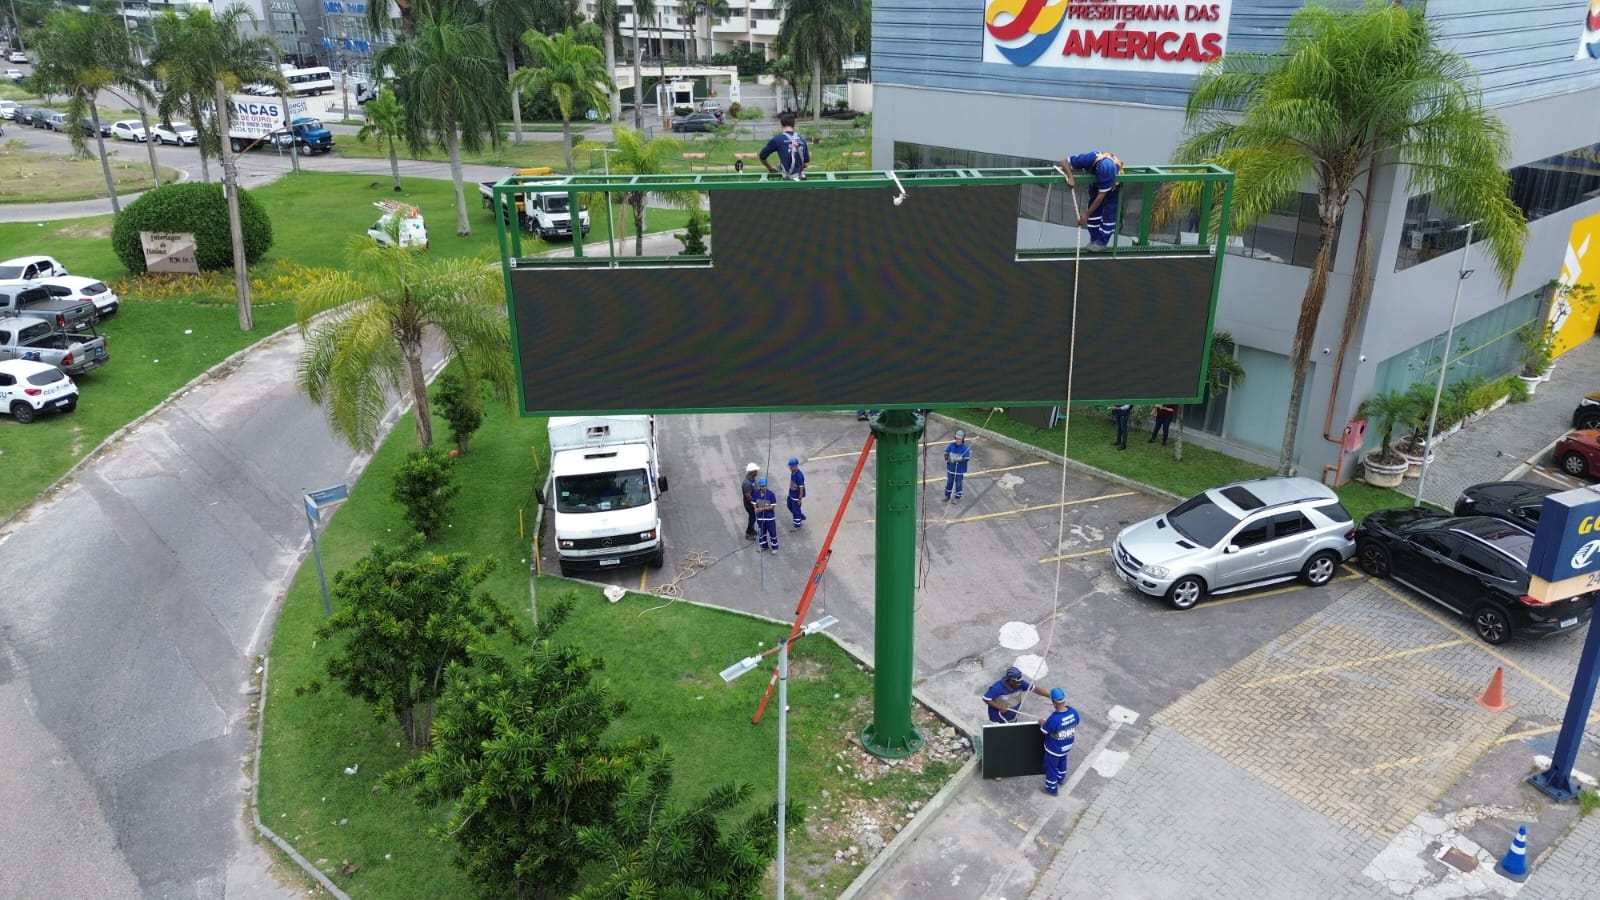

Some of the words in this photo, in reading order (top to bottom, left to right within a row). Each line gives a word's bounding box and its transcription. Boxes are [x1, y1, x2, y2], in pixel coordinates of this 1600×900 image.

[1068, 4, 1179, 21] PRESBITERIANA
[1184, 4, 1220, 21] DAS
[1062, 23, 1223, 62] AMÉRICAS
